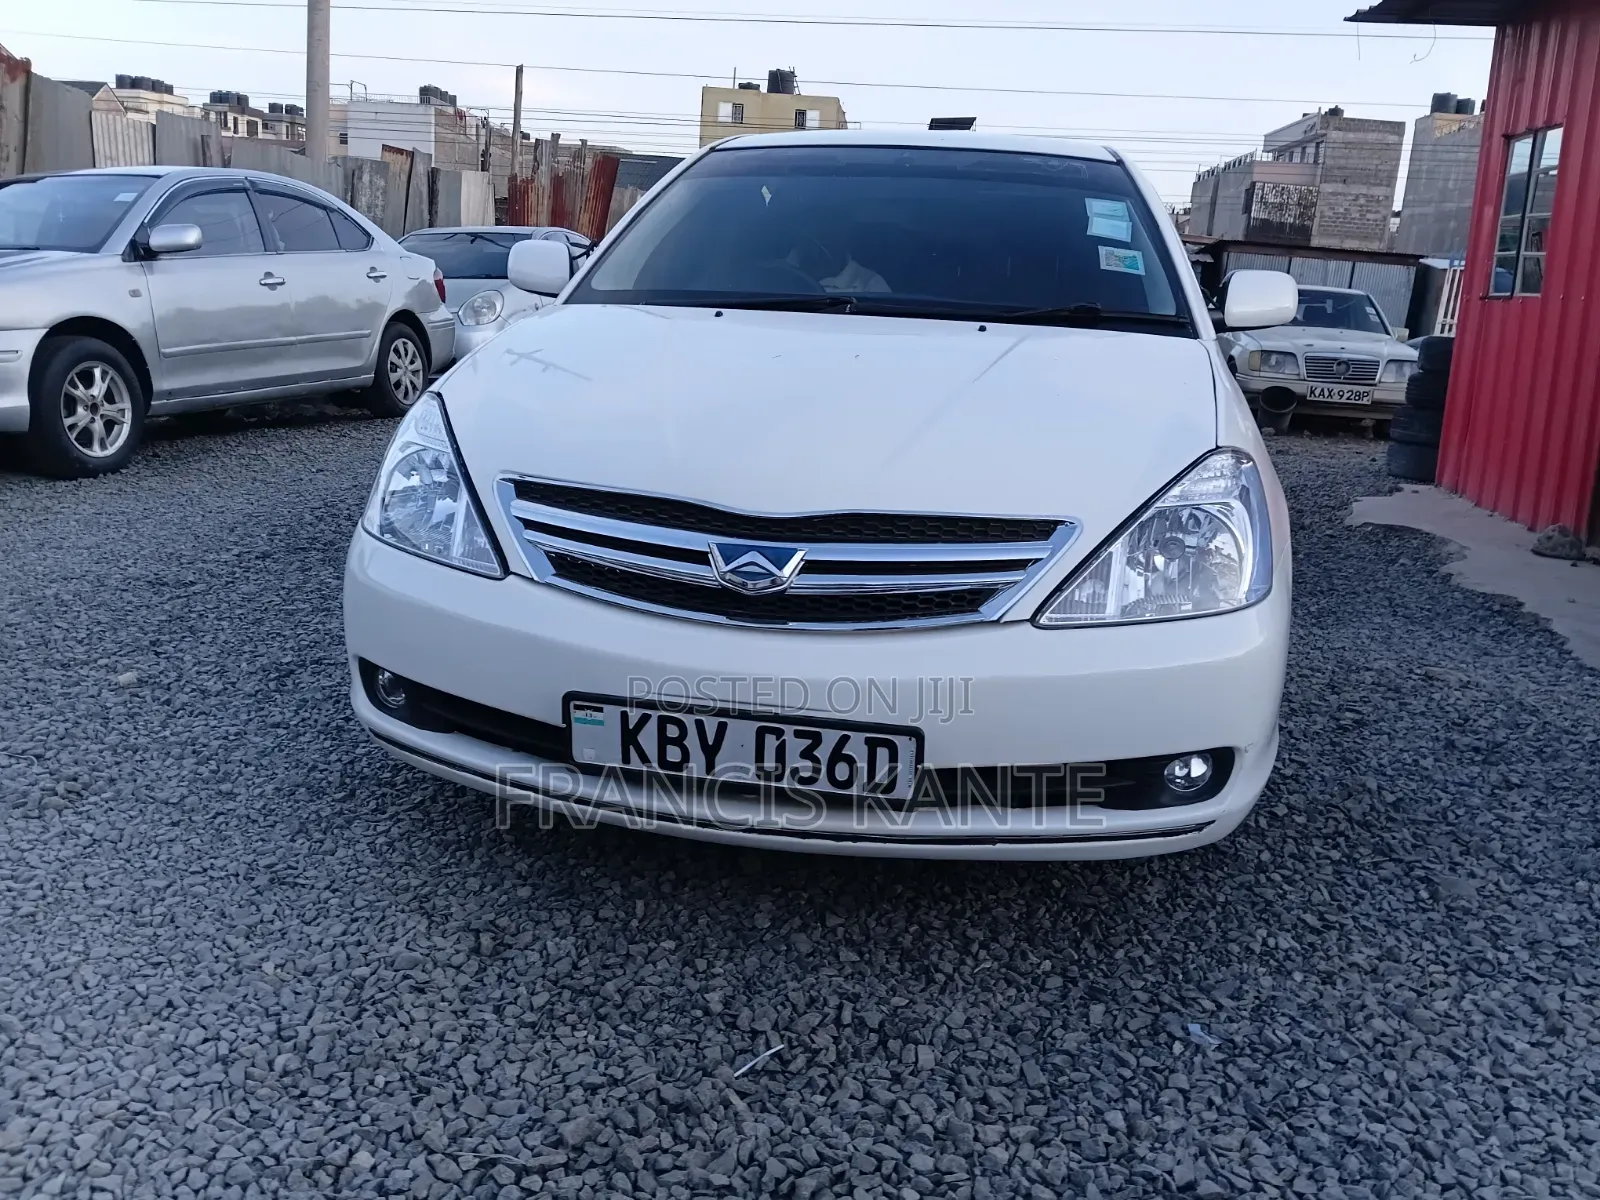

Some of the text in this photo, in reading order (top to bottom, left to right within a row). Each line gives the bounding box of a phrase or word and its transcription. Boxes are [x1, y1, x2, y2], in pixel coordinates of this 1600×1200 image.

[1309, 386, 1369, 402] KAX 928P
[620, 709, 728, 776] KBY
[754, 724, 899, 795] 036D
